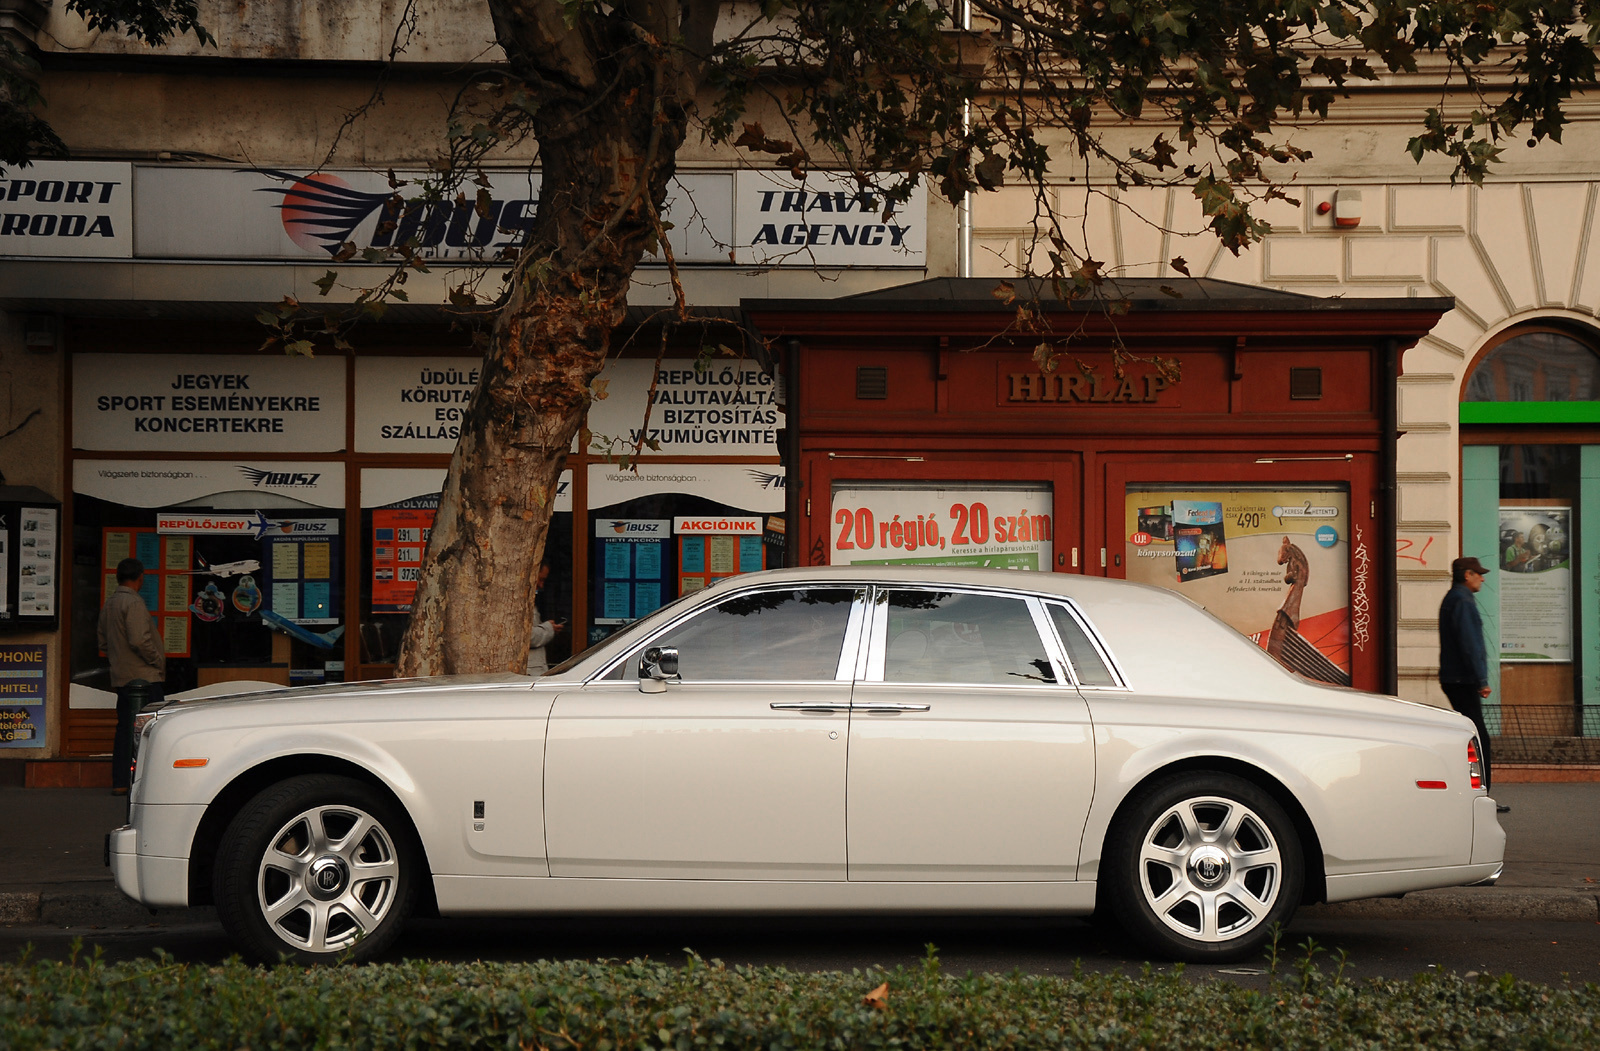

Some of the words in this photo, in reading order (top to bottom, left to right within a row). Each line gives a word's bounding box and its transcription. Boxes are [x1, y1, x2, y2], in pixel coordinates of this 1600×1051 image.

[0, 213, 115, 238] RODA
[750, 223, 912, 246] AGENCY
[171, 373, 250, 390] JEGYEK
[97, 396, 166, 411] SPORT
[171, 392, 321, 412] ESEMÉNYEKRE
[664, 405, 777, 424] BIZTOSÍTÁS
[134, 417, 285, 433] KONCERTEKRE
[380, 421, 460, 440] SZÁLLÁS
[630, 425, 775, 444] VZUMÜGYINTÉ
[98, 469, 139, 479] Világszerte
[265, 472, 321, 486] IBUSZ
[1303, 500, 1312, 515] 2
[160, 518, 246, 531] REPÜLŐJEGY
[293, 522, 327, 532] IBUSZ
[680, 518, 757, 531] AKCIÓINK
[836, 507, 875, 551] 20
[879, 513, 946, 551] régió,
[950, 502, 990, 545] 20
[994, 508, 1052, 543] szám
[1237, 512, 1260, 528] 490
[626, 523, 660, 532] IBUSZ
[1134, 533, 1147, 544] ÚJ!
[951, 547, 977, 555] Keresse
[1137, 549, 1198, 559] könyvsorozat!
[0, 651, 43, 663] HONE
[1, 683, 39, 693] HITEL!
